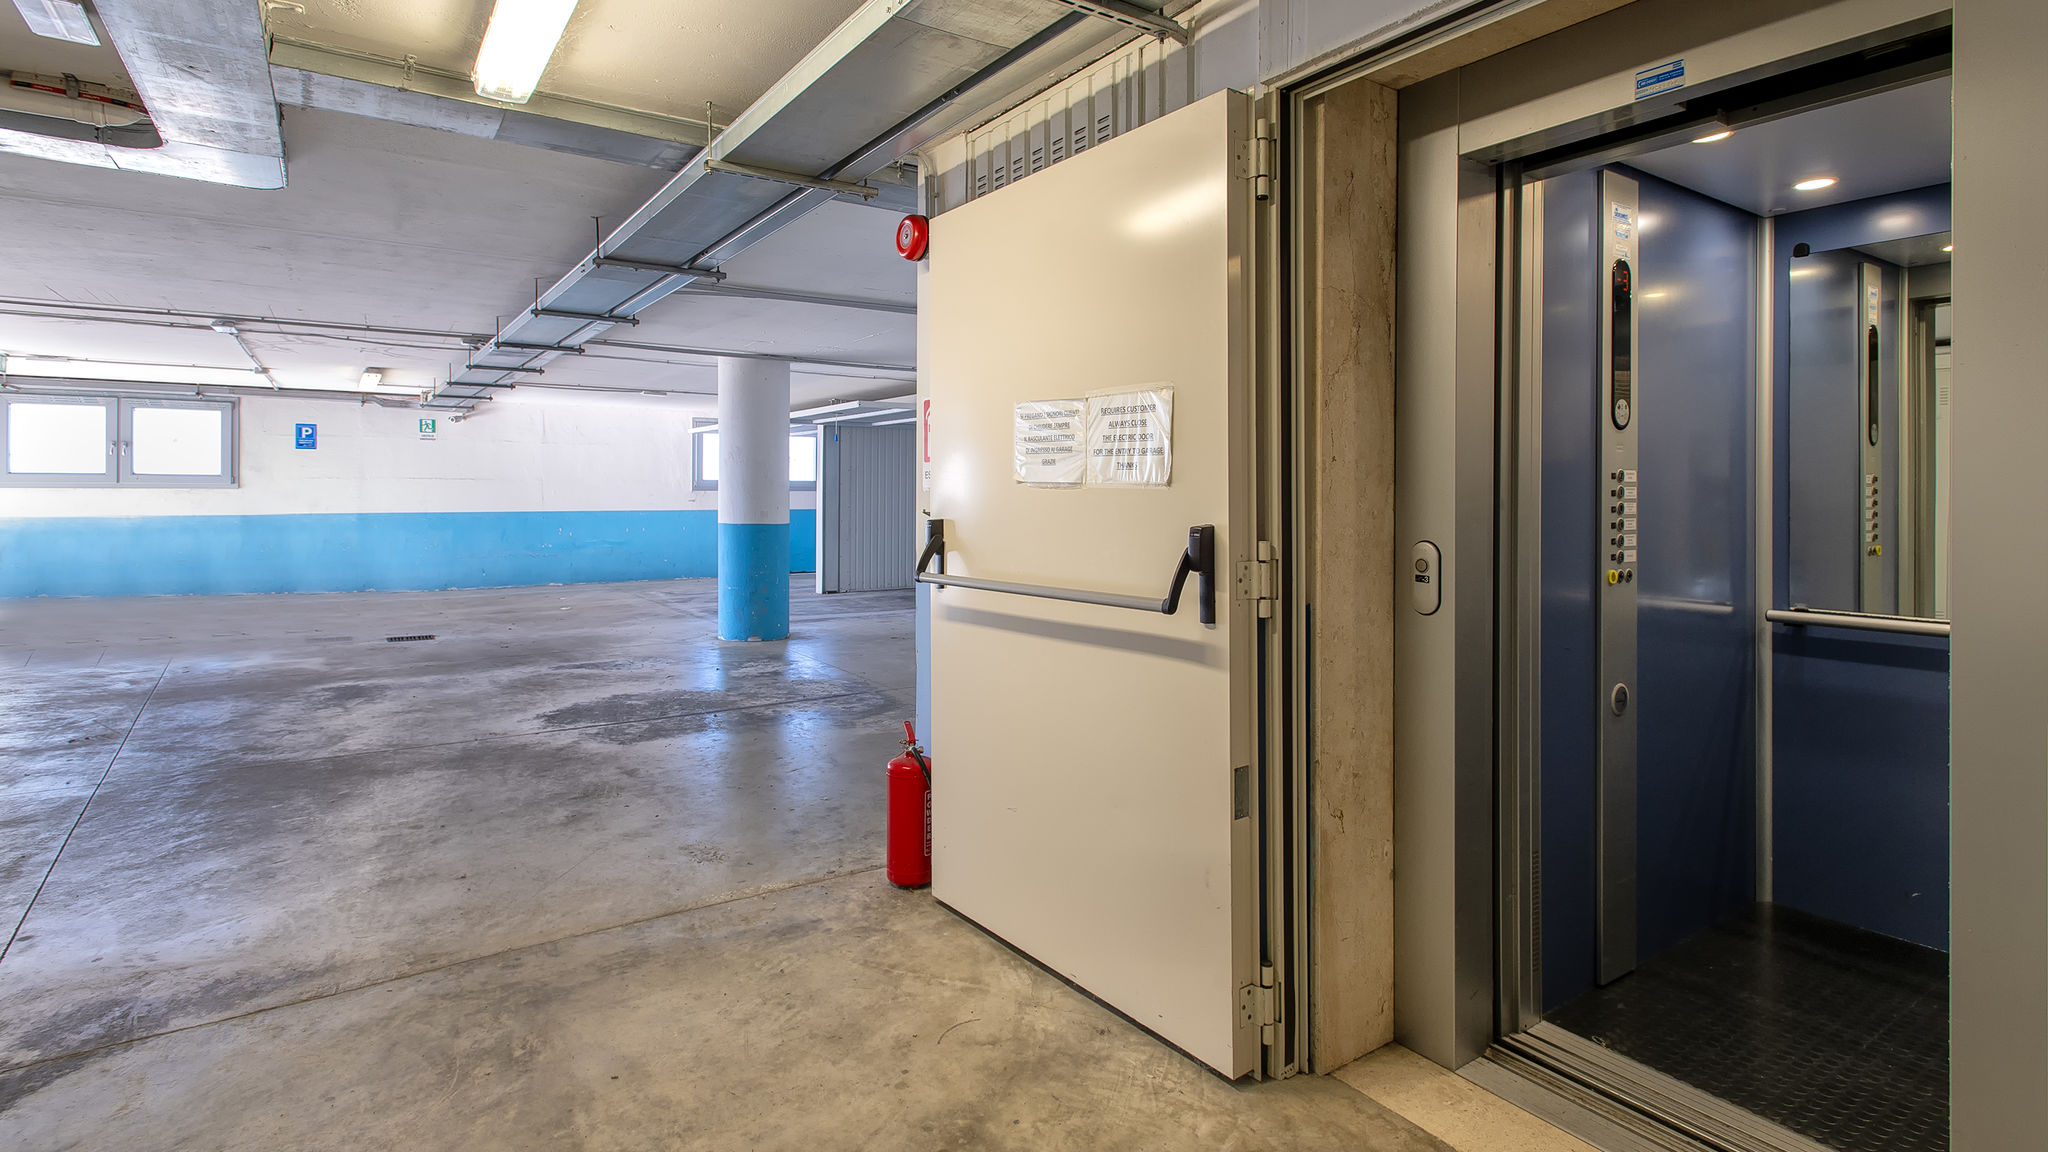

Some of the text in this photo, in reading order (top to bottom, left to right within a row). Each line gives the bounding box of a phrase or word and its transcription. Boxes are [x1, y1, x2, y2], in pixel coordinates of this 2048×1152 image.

[1101, 404, 1156, 415] REQUIRES CUSTOMER
[1108, 419, 1147, 429] ALWAYS CLOSE
[301, 427, 312, 438] P
[1102, 433, 1154, 443] THE ELECTRIC DOOR
[1093, 447, 1164, 456] FOR THE ENTRY TO GARAGE
[1117, 462, 1138, 470] THANKS
